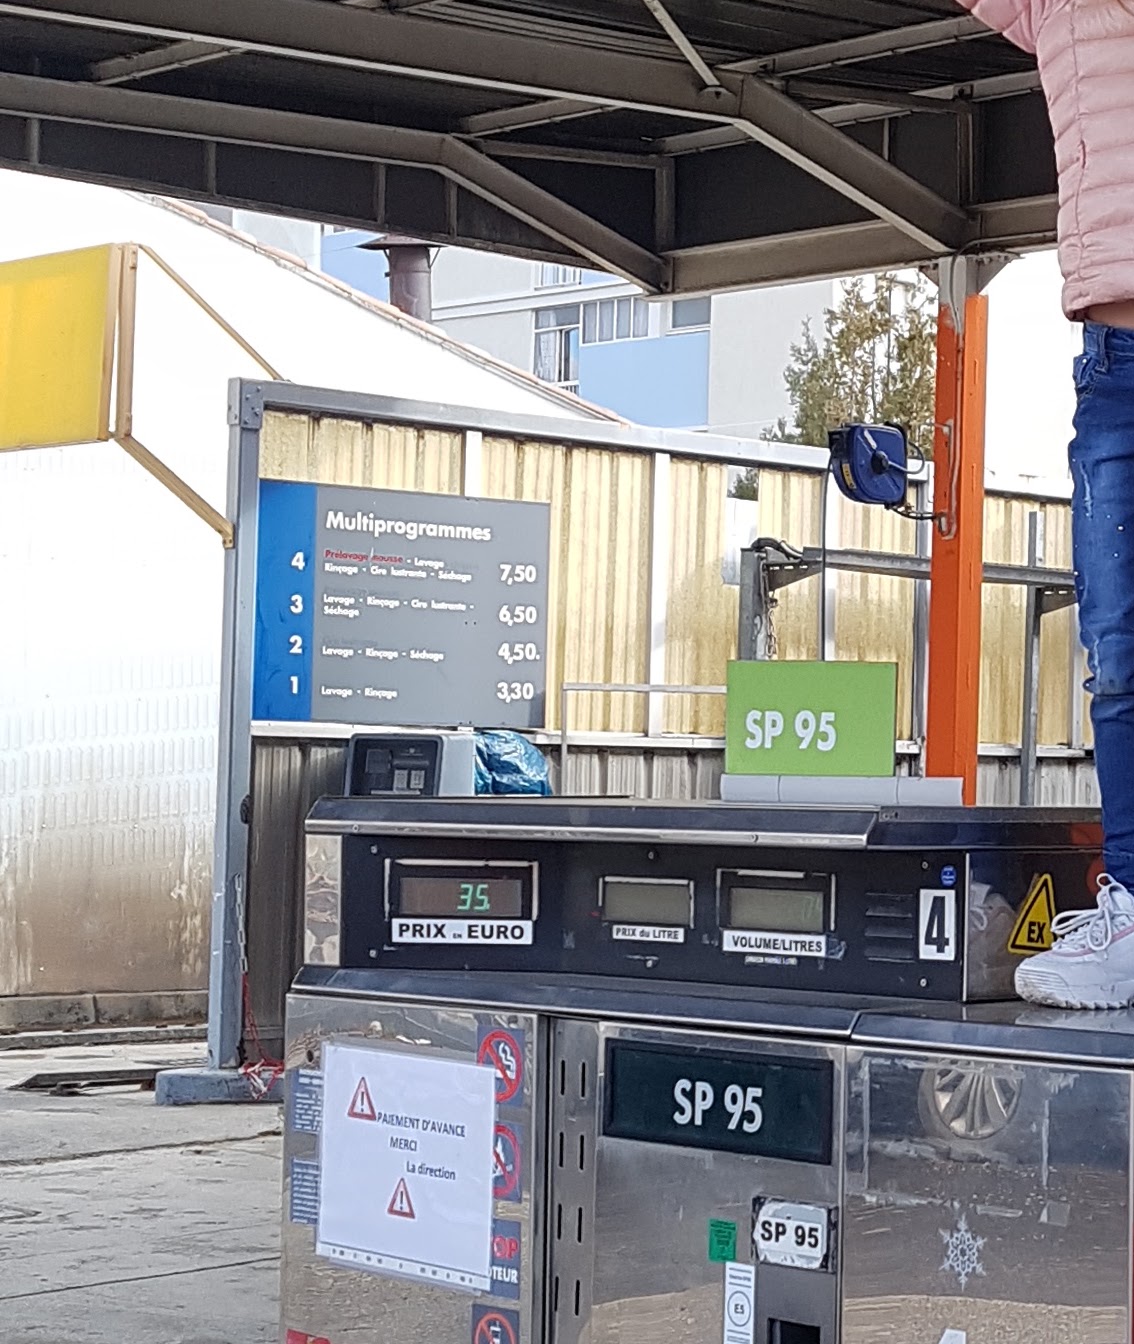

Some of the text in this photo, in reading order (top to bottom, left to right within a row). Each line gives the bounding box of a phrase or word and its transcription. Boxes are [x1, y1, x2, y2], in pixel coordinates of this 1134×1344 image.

[325, 510, 491, 542] Multiprogrammes
[291, 551, 305, 570] 4
[414, 557, 445, 570] Lavage
[500, 564, 537, 586] 7,50
[289, 595, 303, 614] 3
[323, 594, 355, 606] Lavage
[499, 605, 537, 626] 6,50
[289, 636, 302, 654] 2
[322, 646, 354, 658] Lavage
[290, 676, 299, 694] 1
[321, 685, 353, 698] Lavage
[496, 681, 534, 703] 3,30
[744, 709, 837, 752] SP 95
[398, 923, 447, 939] PRIX
[467, 924, 525, 940] EURO
[615, 927, 679, 940] PRIX du LITRE
[924, 895, 950, 954] 4
[1027, 921, 1047, 944] EX
[732, 934, 823, 953] VOLUME/LITRES
[673, 1078, 763, 1134] SP 95
[377, 1112, 466, 1138] PAIEMENT D'AVANCE
[389, 1136, 417, 1152] MERCI
[406, 1160, 456, 1180] La direction
[760, 1221, 787, 1244] SP
[794, 1224, 820, 1249] 95
